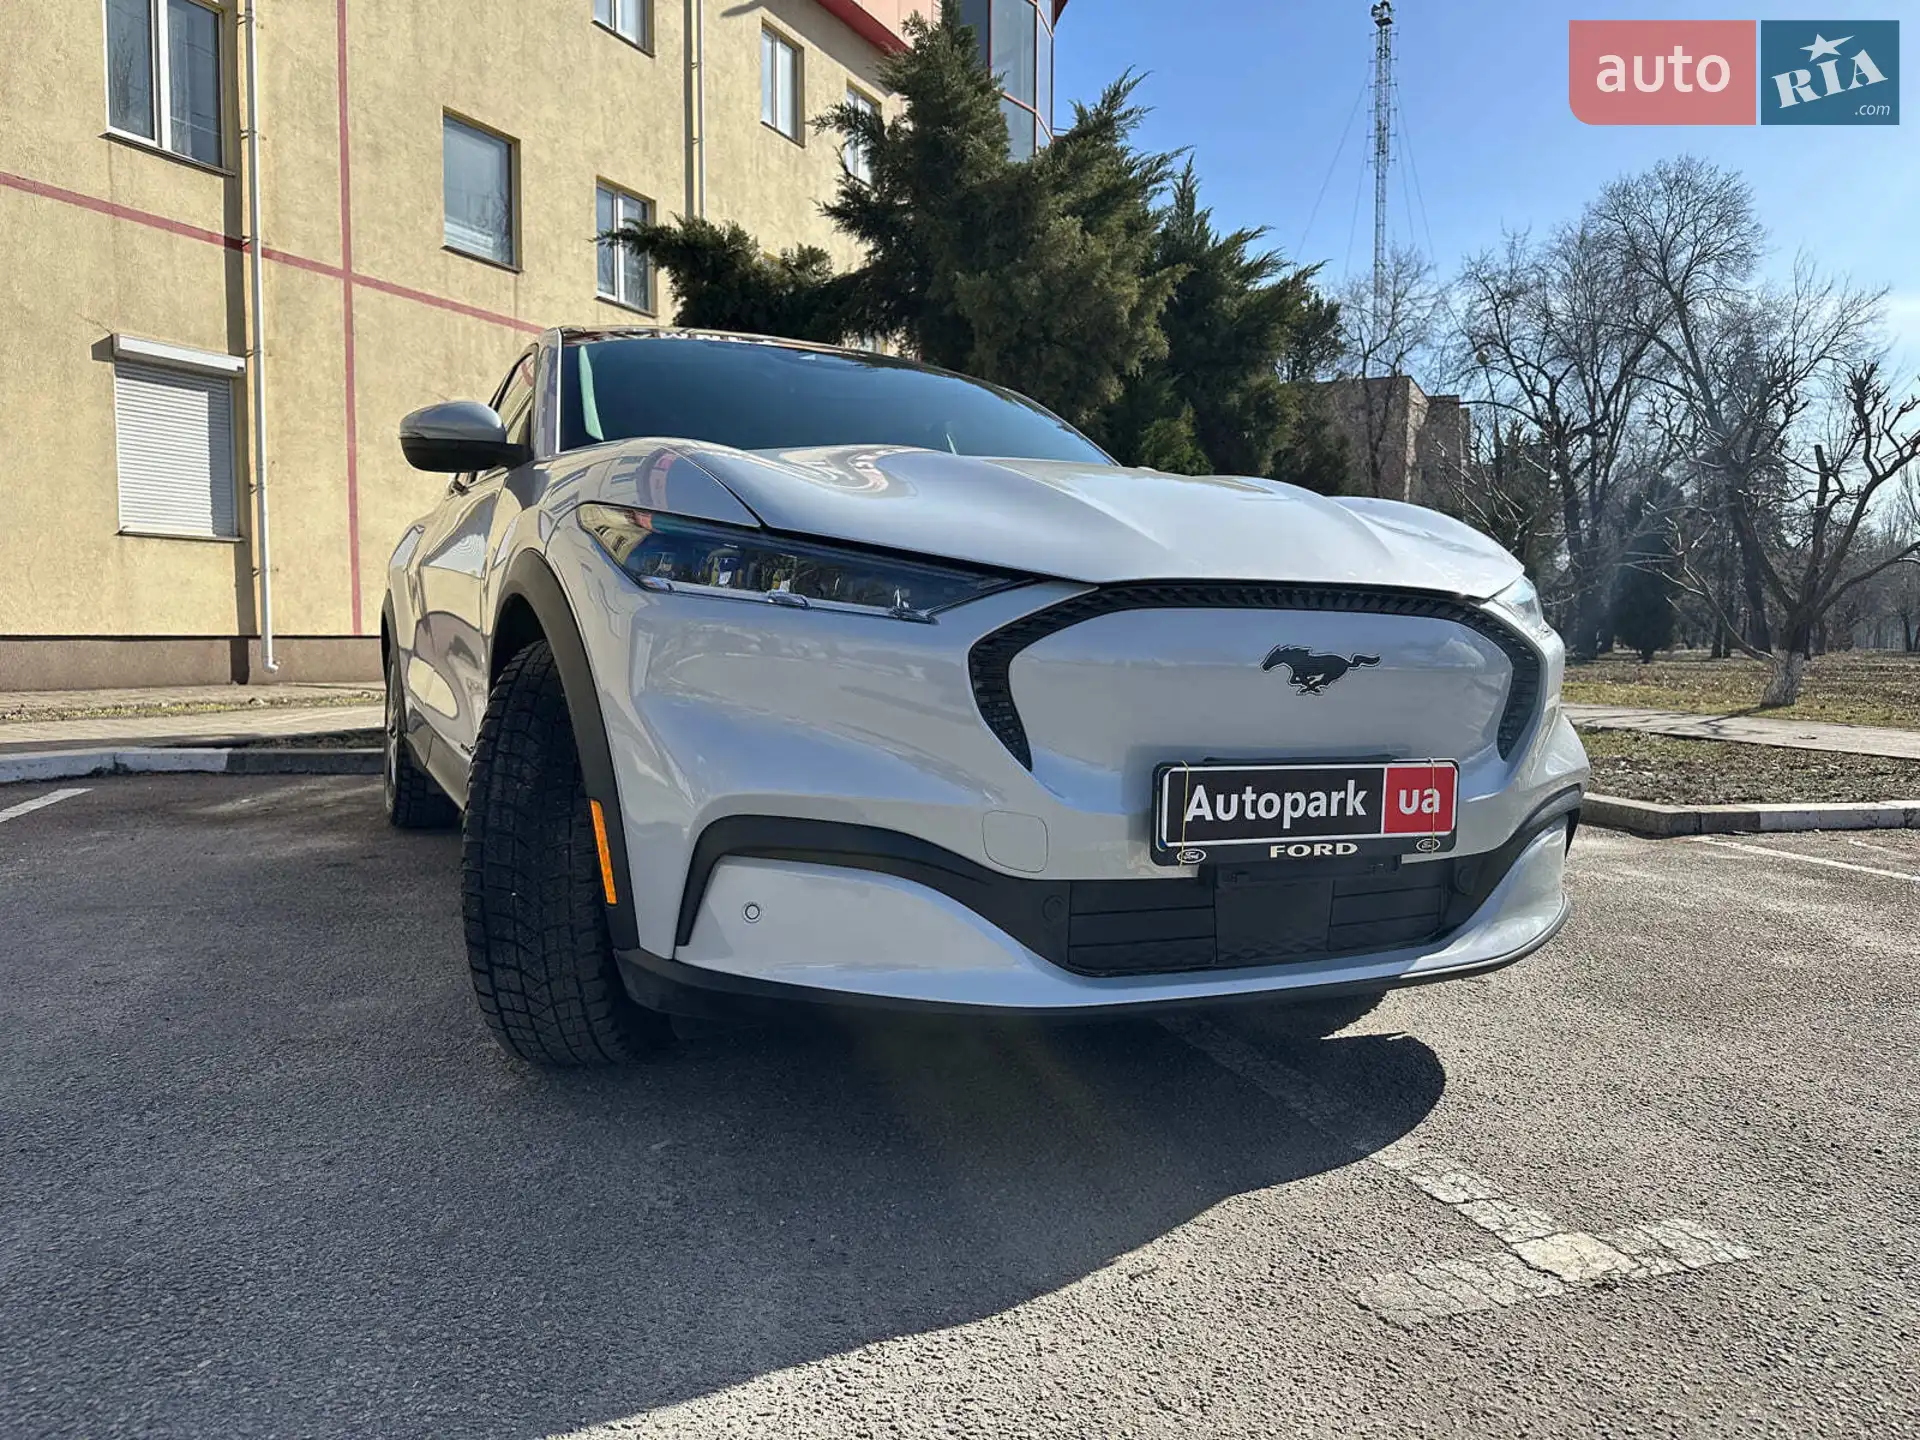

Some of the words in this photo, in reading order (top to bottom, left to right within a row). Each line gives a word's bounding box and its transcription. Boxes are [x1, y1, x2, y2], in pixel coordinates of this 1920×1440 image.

[1185, 779, 1368, 830] Autopark
[1398, 786, 1441, 815] ua
[1270, 842, 1358, 858] FORD
